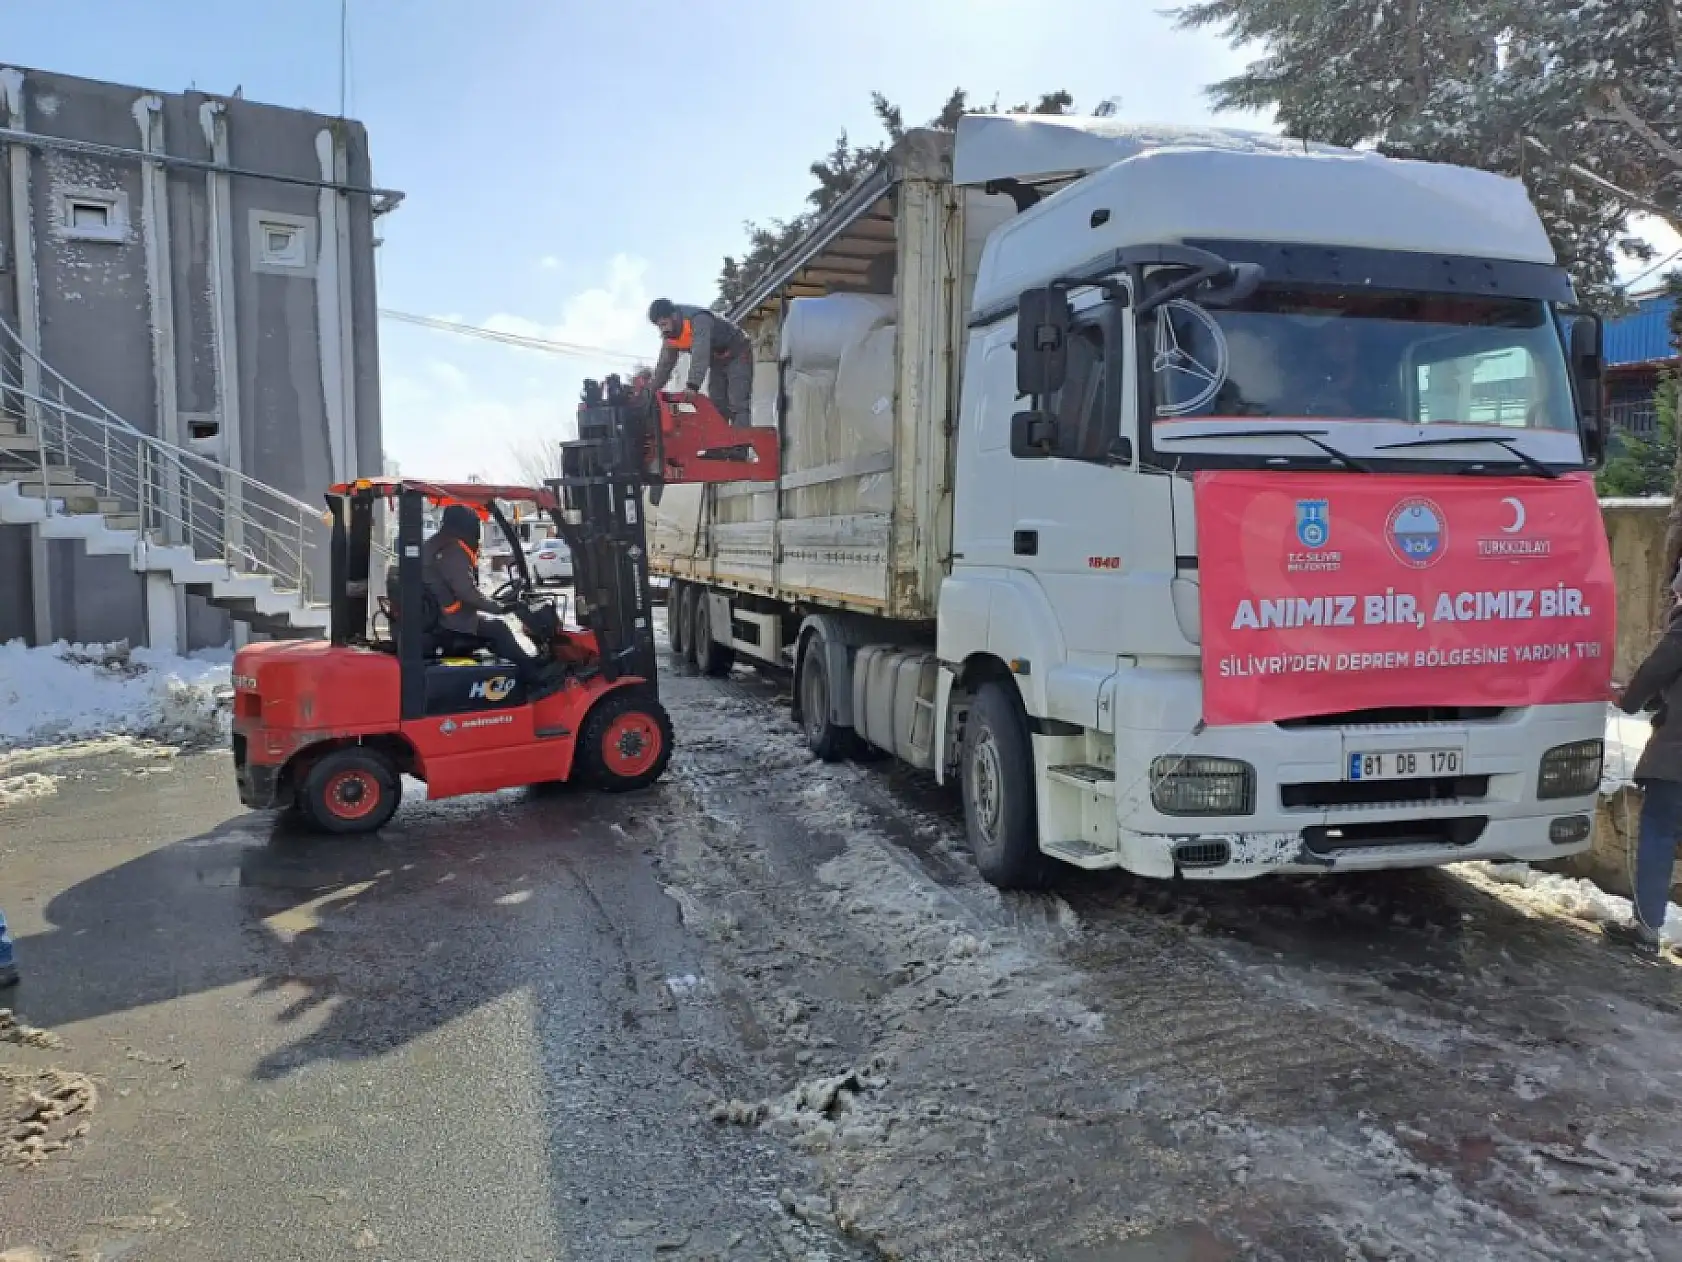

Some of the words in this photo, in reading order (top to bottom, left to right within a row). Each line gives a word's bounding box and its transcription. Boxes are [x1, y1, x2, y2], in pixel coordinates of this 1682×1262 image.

[1231, 596, 1357, 630] ANIMIZ
[1363, 587, 1426, 630] BİR,
[1433, 590, 1535, 621] ACIMIZ
[1540, 580, 1592, 617] BİR.
[1219, 652, 1331, 677] SİLİVRİ'DEN
[1335, 651, 1409, 671] DEPREM
[1414, 643, 1509, 667] BÖLGESİNE
[1513, 642, 1570, 664] YARDIM
[1365, 755, 1382, 776] 81
[1430, 751, 1457, 772] 170
